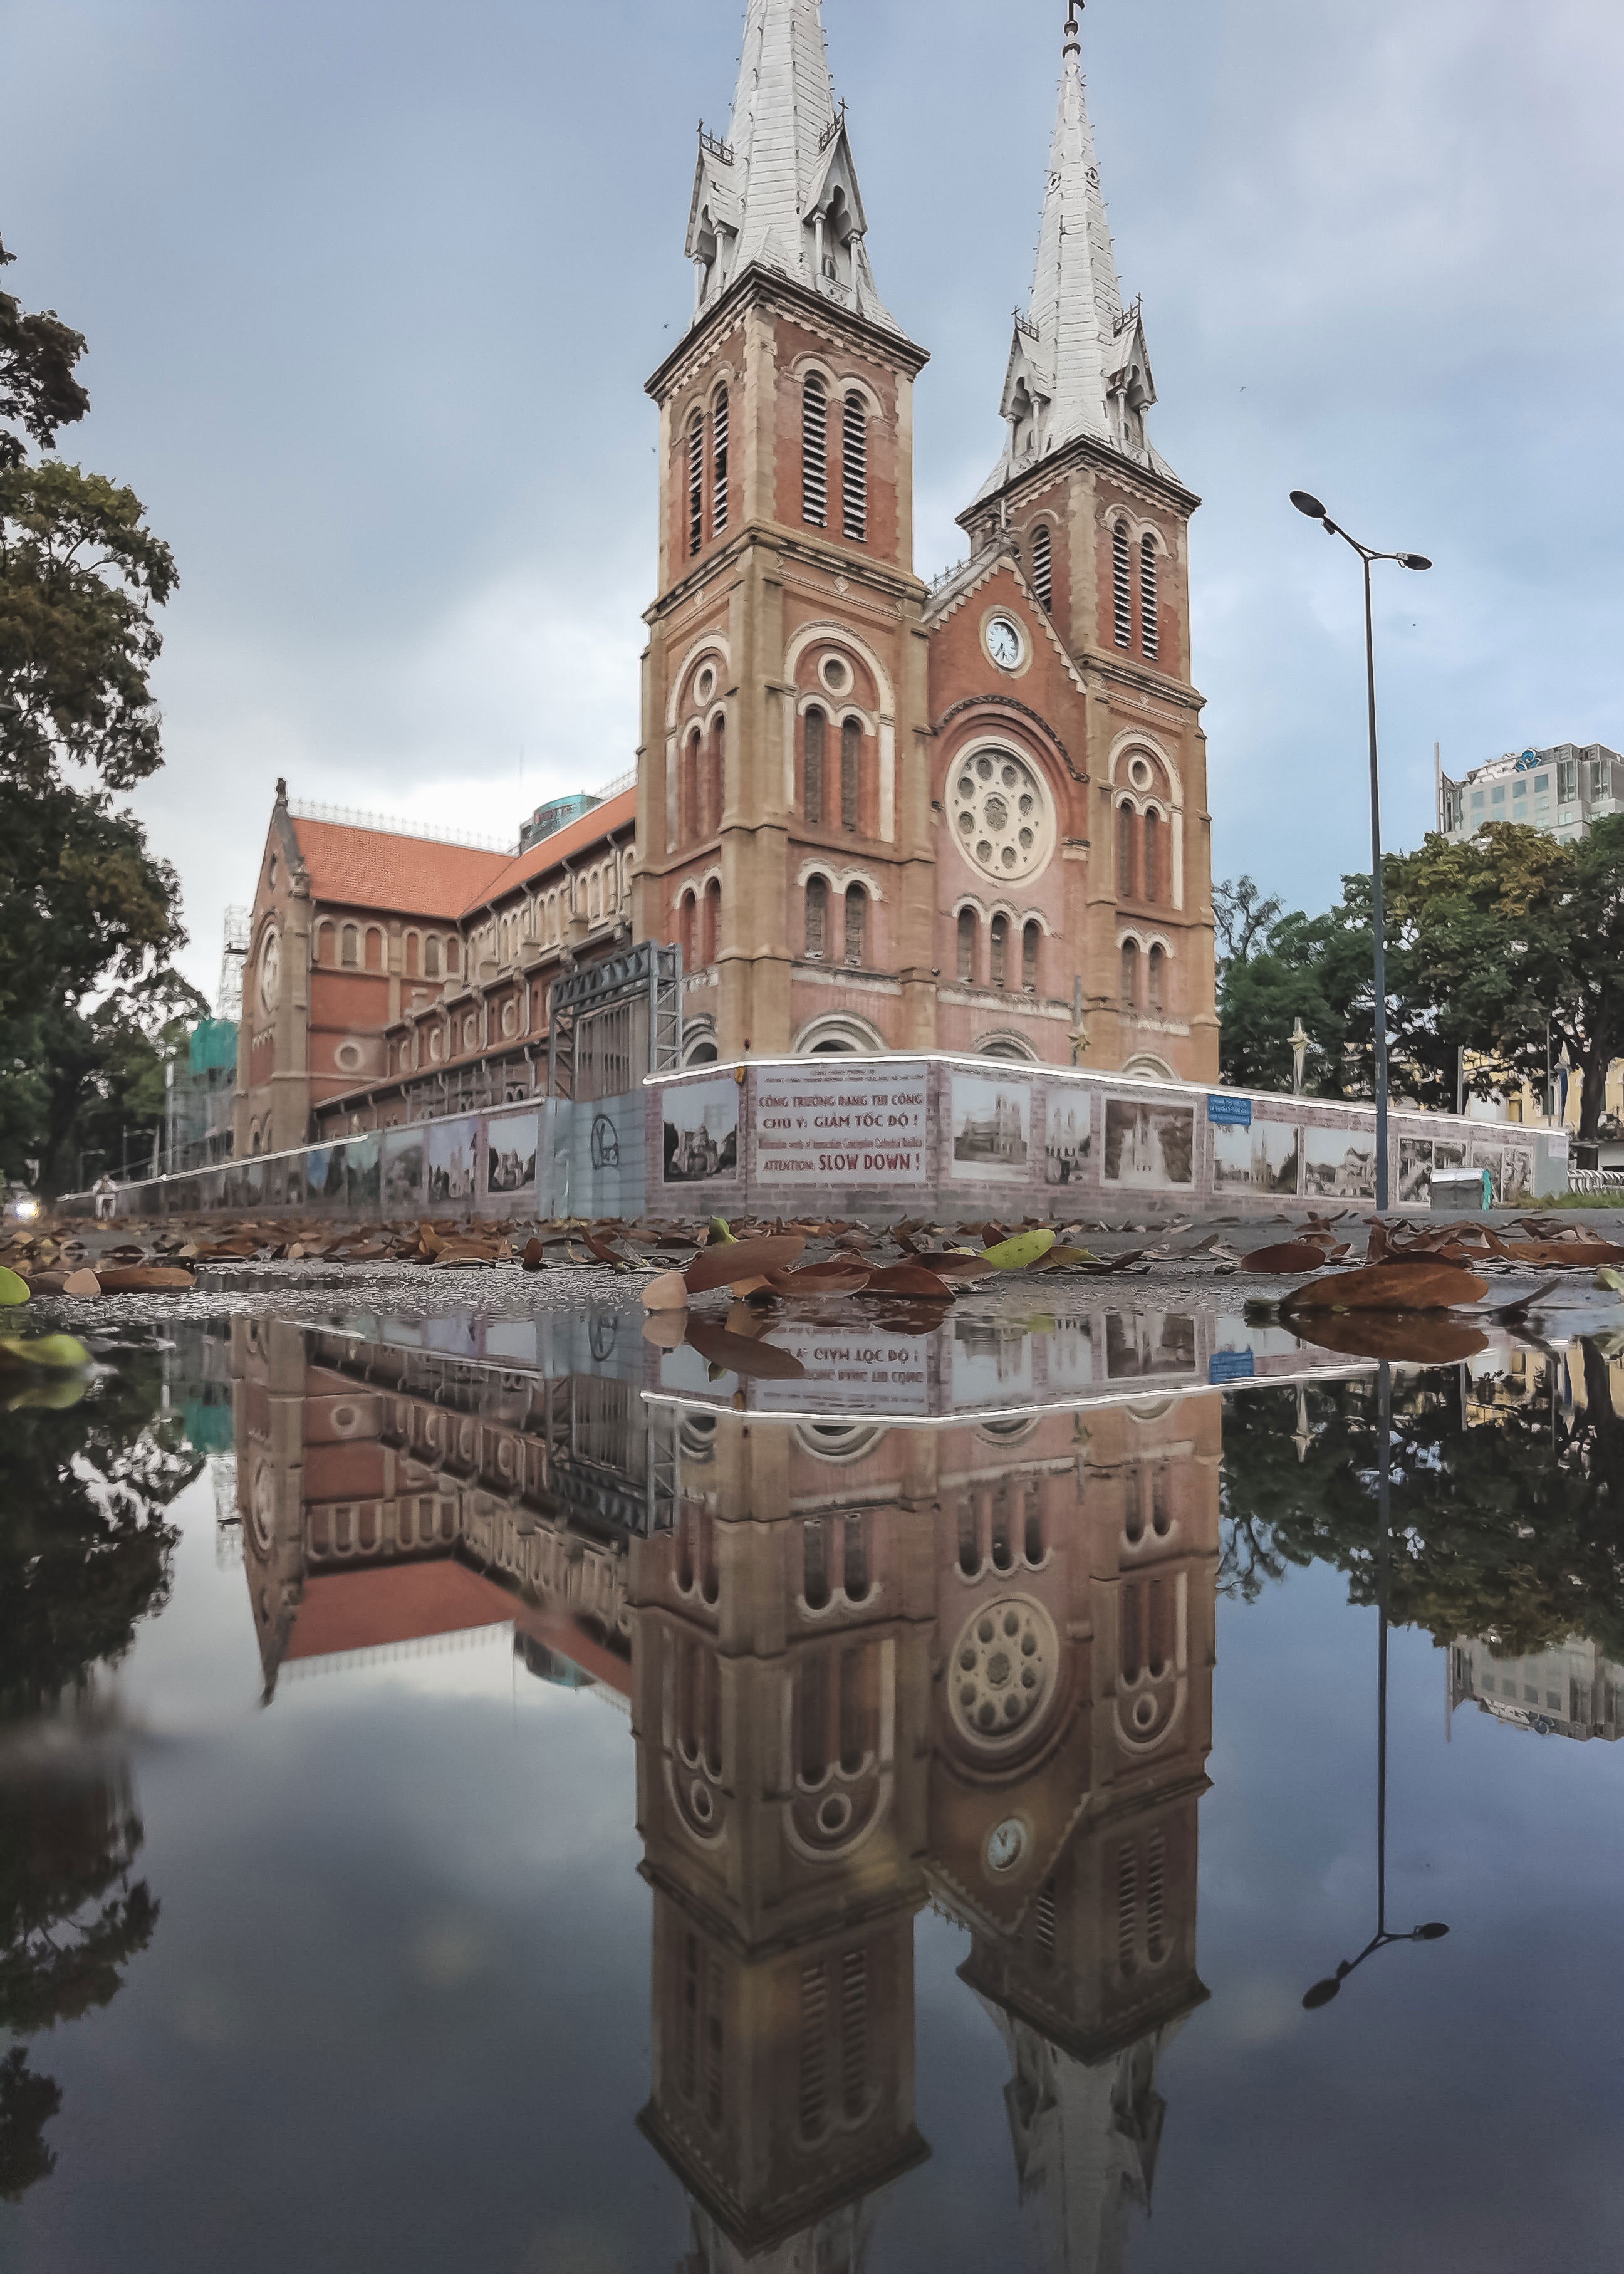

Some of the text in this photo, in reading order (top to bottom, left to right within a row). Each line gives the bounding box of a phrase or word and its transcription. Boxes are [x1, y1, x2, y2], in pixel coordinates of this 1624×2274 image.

[891, 1092, 922, 1105] CÔNG
[855, 1111, 884, 1128] TỐC
[818, 1154, 858, 1171] SLOW
[864, 1153, 910, 1171] DOWN
